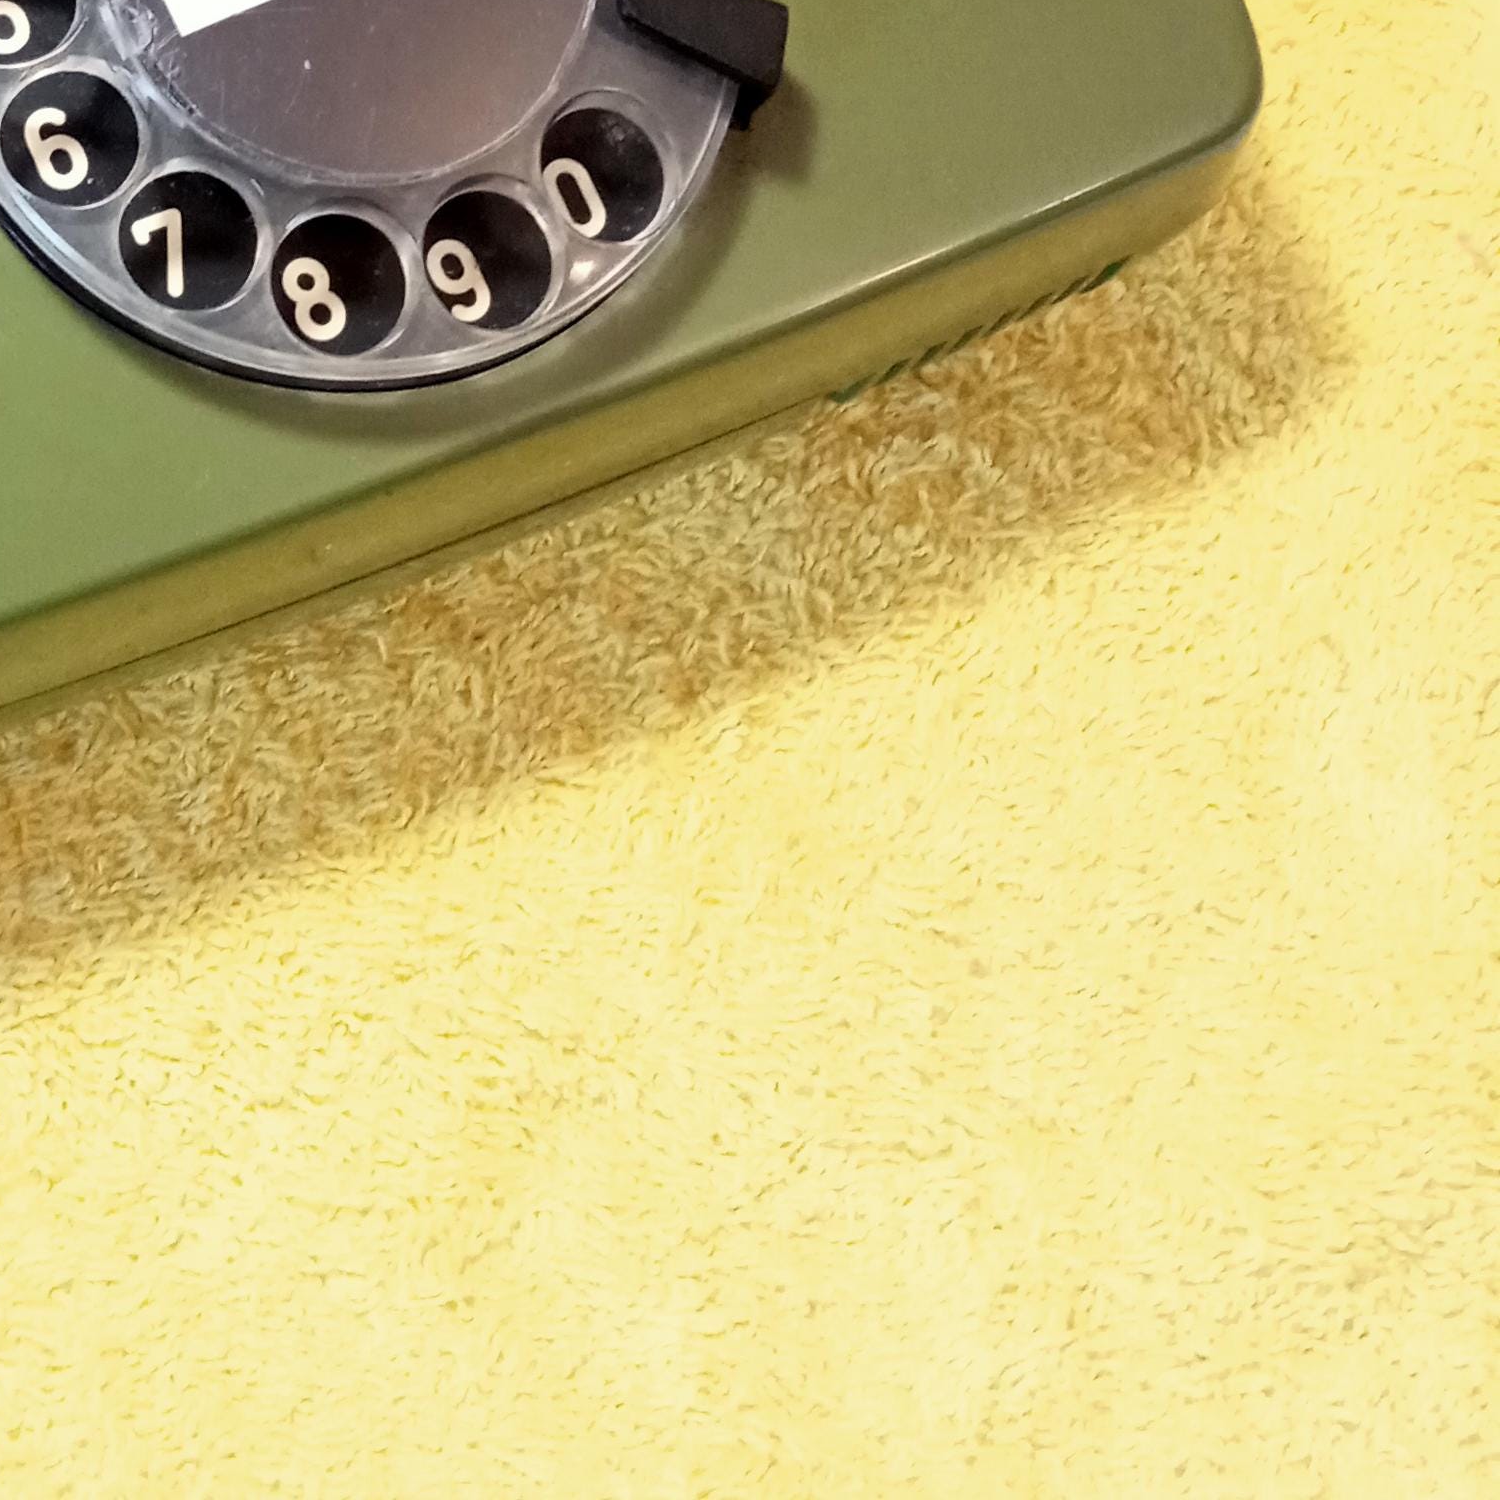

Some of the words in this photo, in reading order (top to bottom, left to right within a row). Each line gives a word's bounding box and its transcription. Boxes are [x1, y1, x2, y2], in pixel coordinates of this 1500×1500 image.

[23, 106, 89, 191] 6
[543, 158, 608, 239] 0
[131, 208, 185, 298] 7
[426, 239, 491, 323] 9
[282, 257, 347, 342] 8
